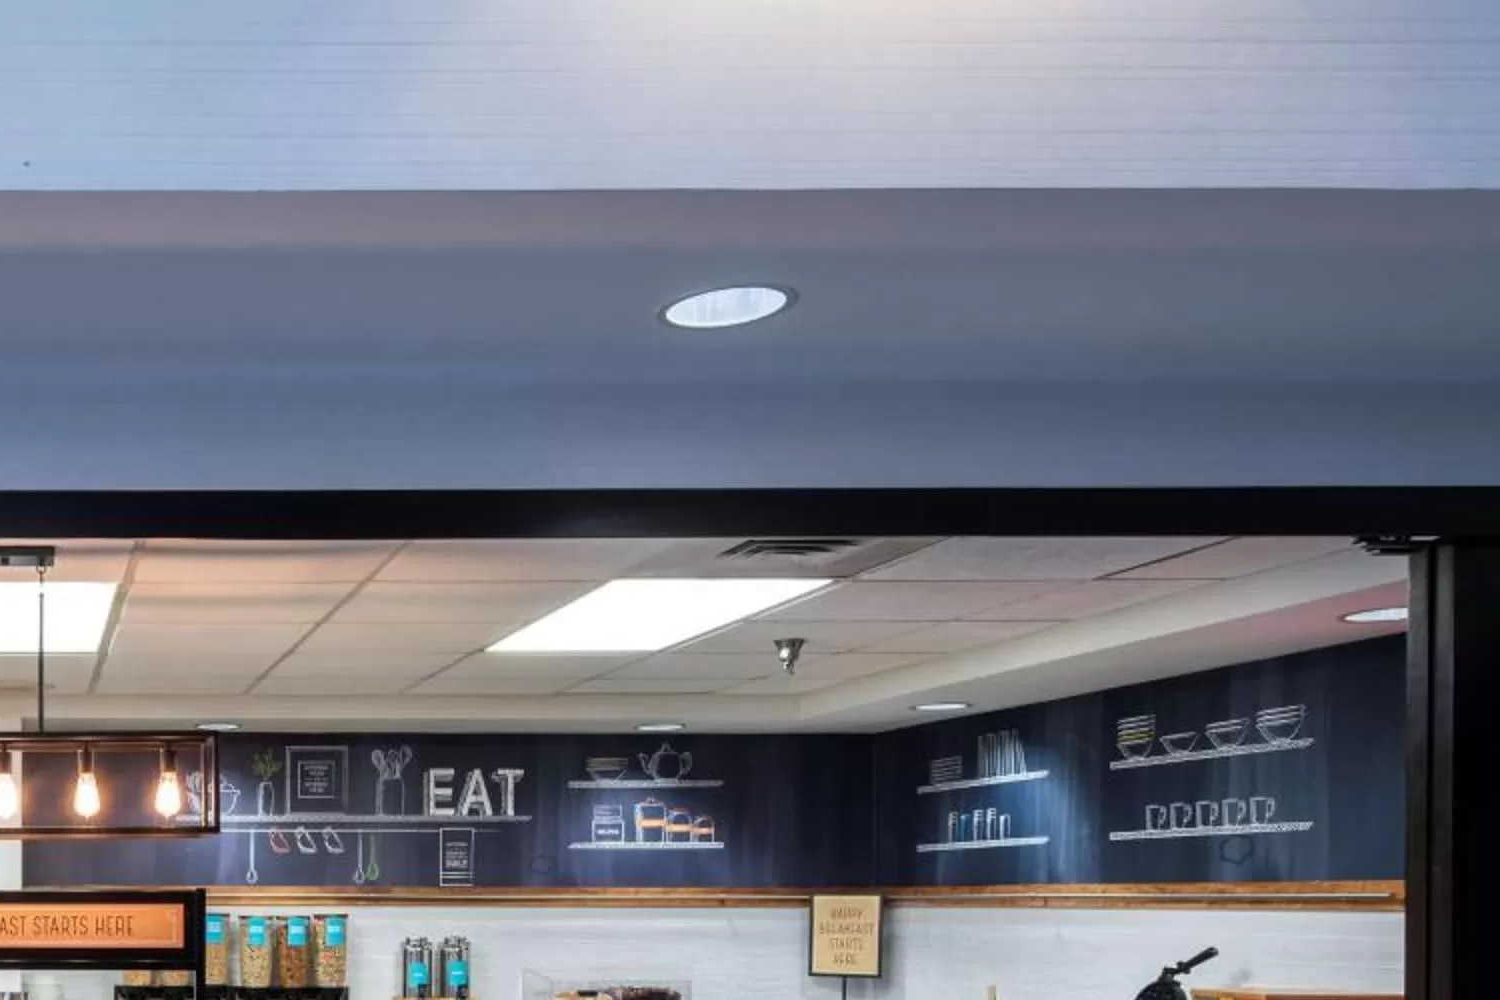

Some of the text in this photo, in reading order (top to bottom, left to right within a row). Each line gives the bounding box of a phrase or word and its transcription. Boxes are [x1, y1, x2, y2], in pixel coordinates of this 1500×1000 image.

[424, 768, 524, 817] EAT
[33, 915, 89, 937] STARTS
[95, 915, 135, 937] HERE
